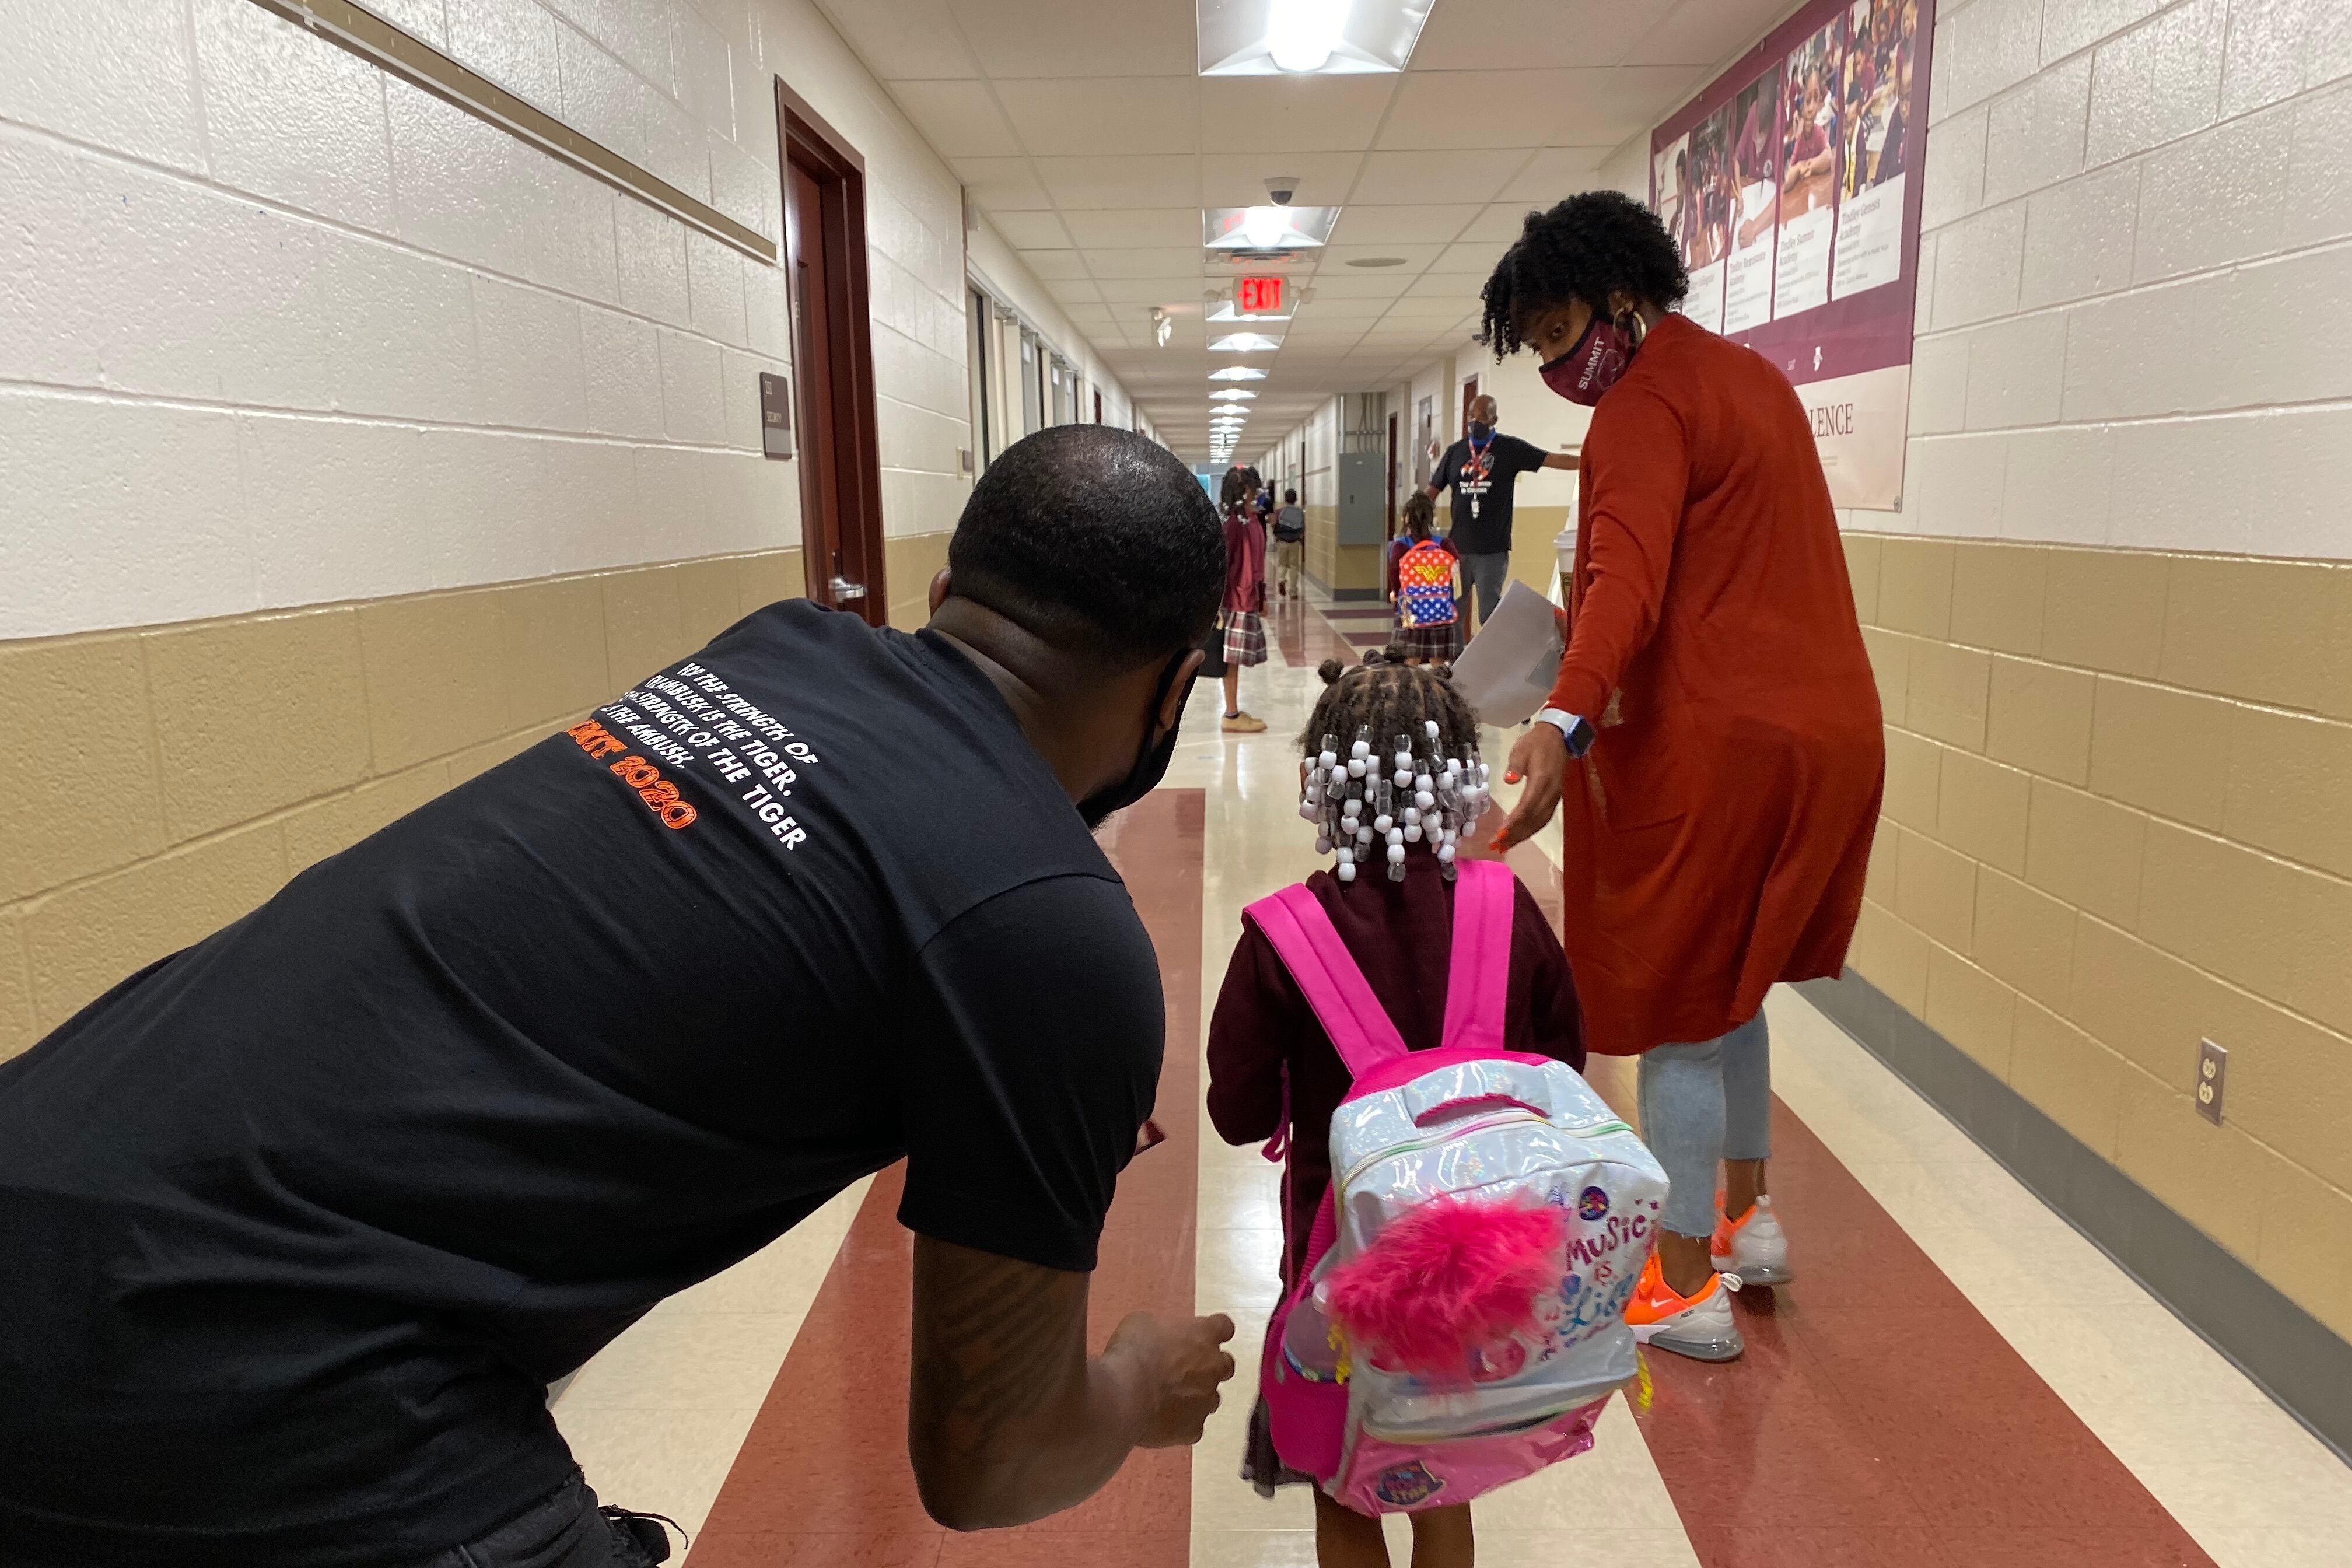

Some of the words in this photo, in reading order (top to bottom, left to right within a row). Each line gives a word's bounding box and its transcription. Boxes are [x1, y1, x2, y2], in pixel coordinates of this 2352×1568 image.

[1242, 278, 1283, 312] EXIT
[1578, 336, 1605, 390] SUMMIT
[607, 706, 642, 724] THE
[693, 673, 729, 692] THE
[715, 692, 794, 741] STRENGTH
[783, 742, 819, 764] OF
[698, 709, 726, 722] IS
[713, 719, 753, 741] THE
[739, 738, 797, 797] TIGER.
[610, 755, 698, 830] 2020
[687, 732, 720, 747] OF
[707, 747, 752, 784] THE
[741, 783, 807, 852] TIGER
